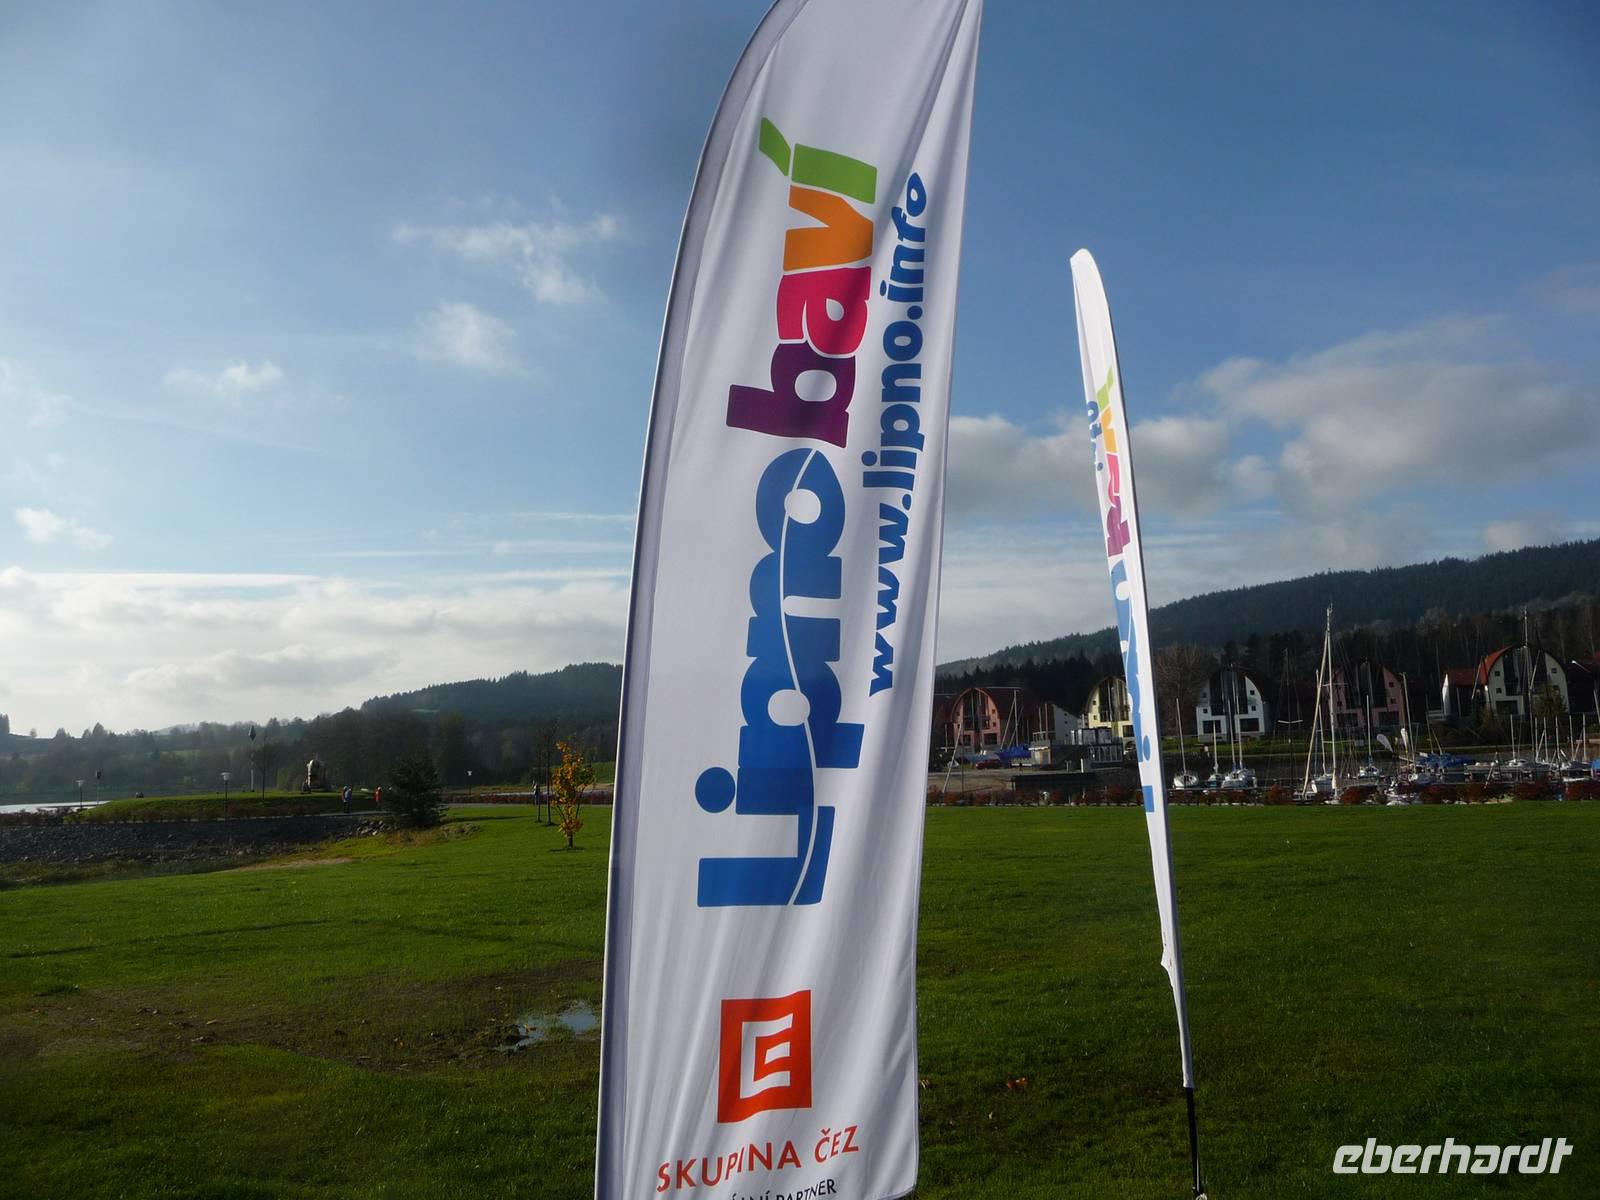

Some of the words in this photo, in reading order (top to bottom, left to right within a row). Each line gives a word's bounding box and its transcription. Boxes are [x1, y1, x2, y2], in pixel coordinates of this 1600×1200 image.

[863, 172, 927, 697] www.lipno.info
[657, 1140, 801, 1192] SKUPINA
[814, 1125, 859, 1163] ČEZ
